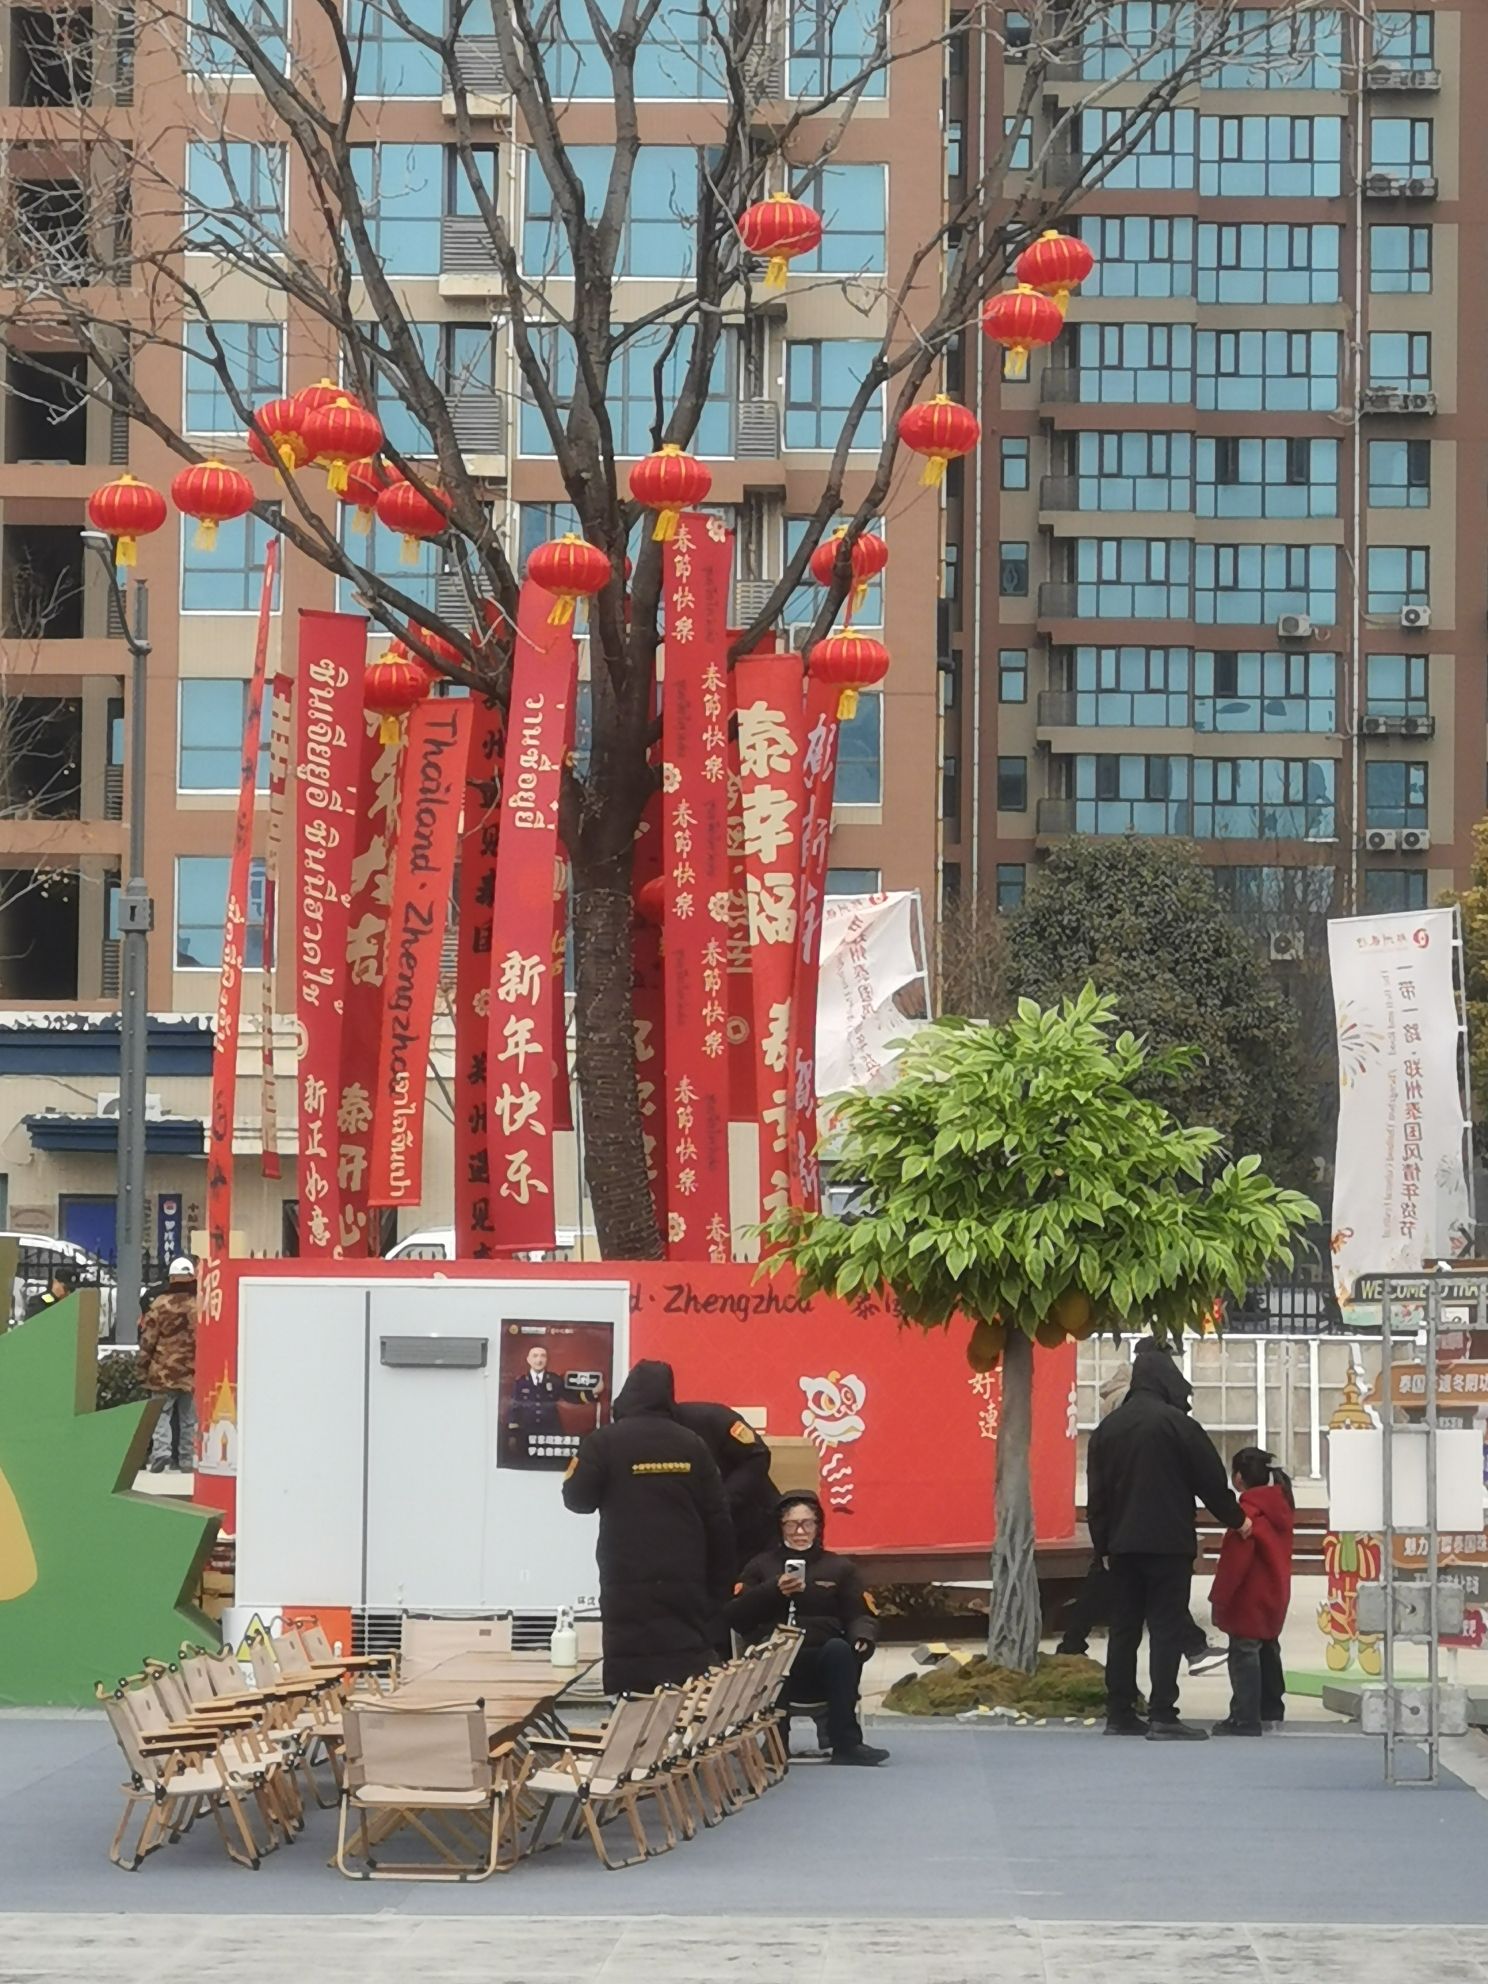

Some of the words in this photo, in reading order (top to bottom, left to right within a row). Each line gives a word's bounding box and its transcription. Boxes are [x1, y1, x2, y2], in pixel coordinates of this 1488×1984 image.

[409, 708, 459, 877] Thailand
[738, 700, 799, 946] 泰幸福
[303, 1073, 333, 1247] 新正如意
[494, 949, 549, 1205] 新年快乐
[336, 1082, 374, 1247] 泰开心
[1361, 1280, 1427, 1299] WECOME
